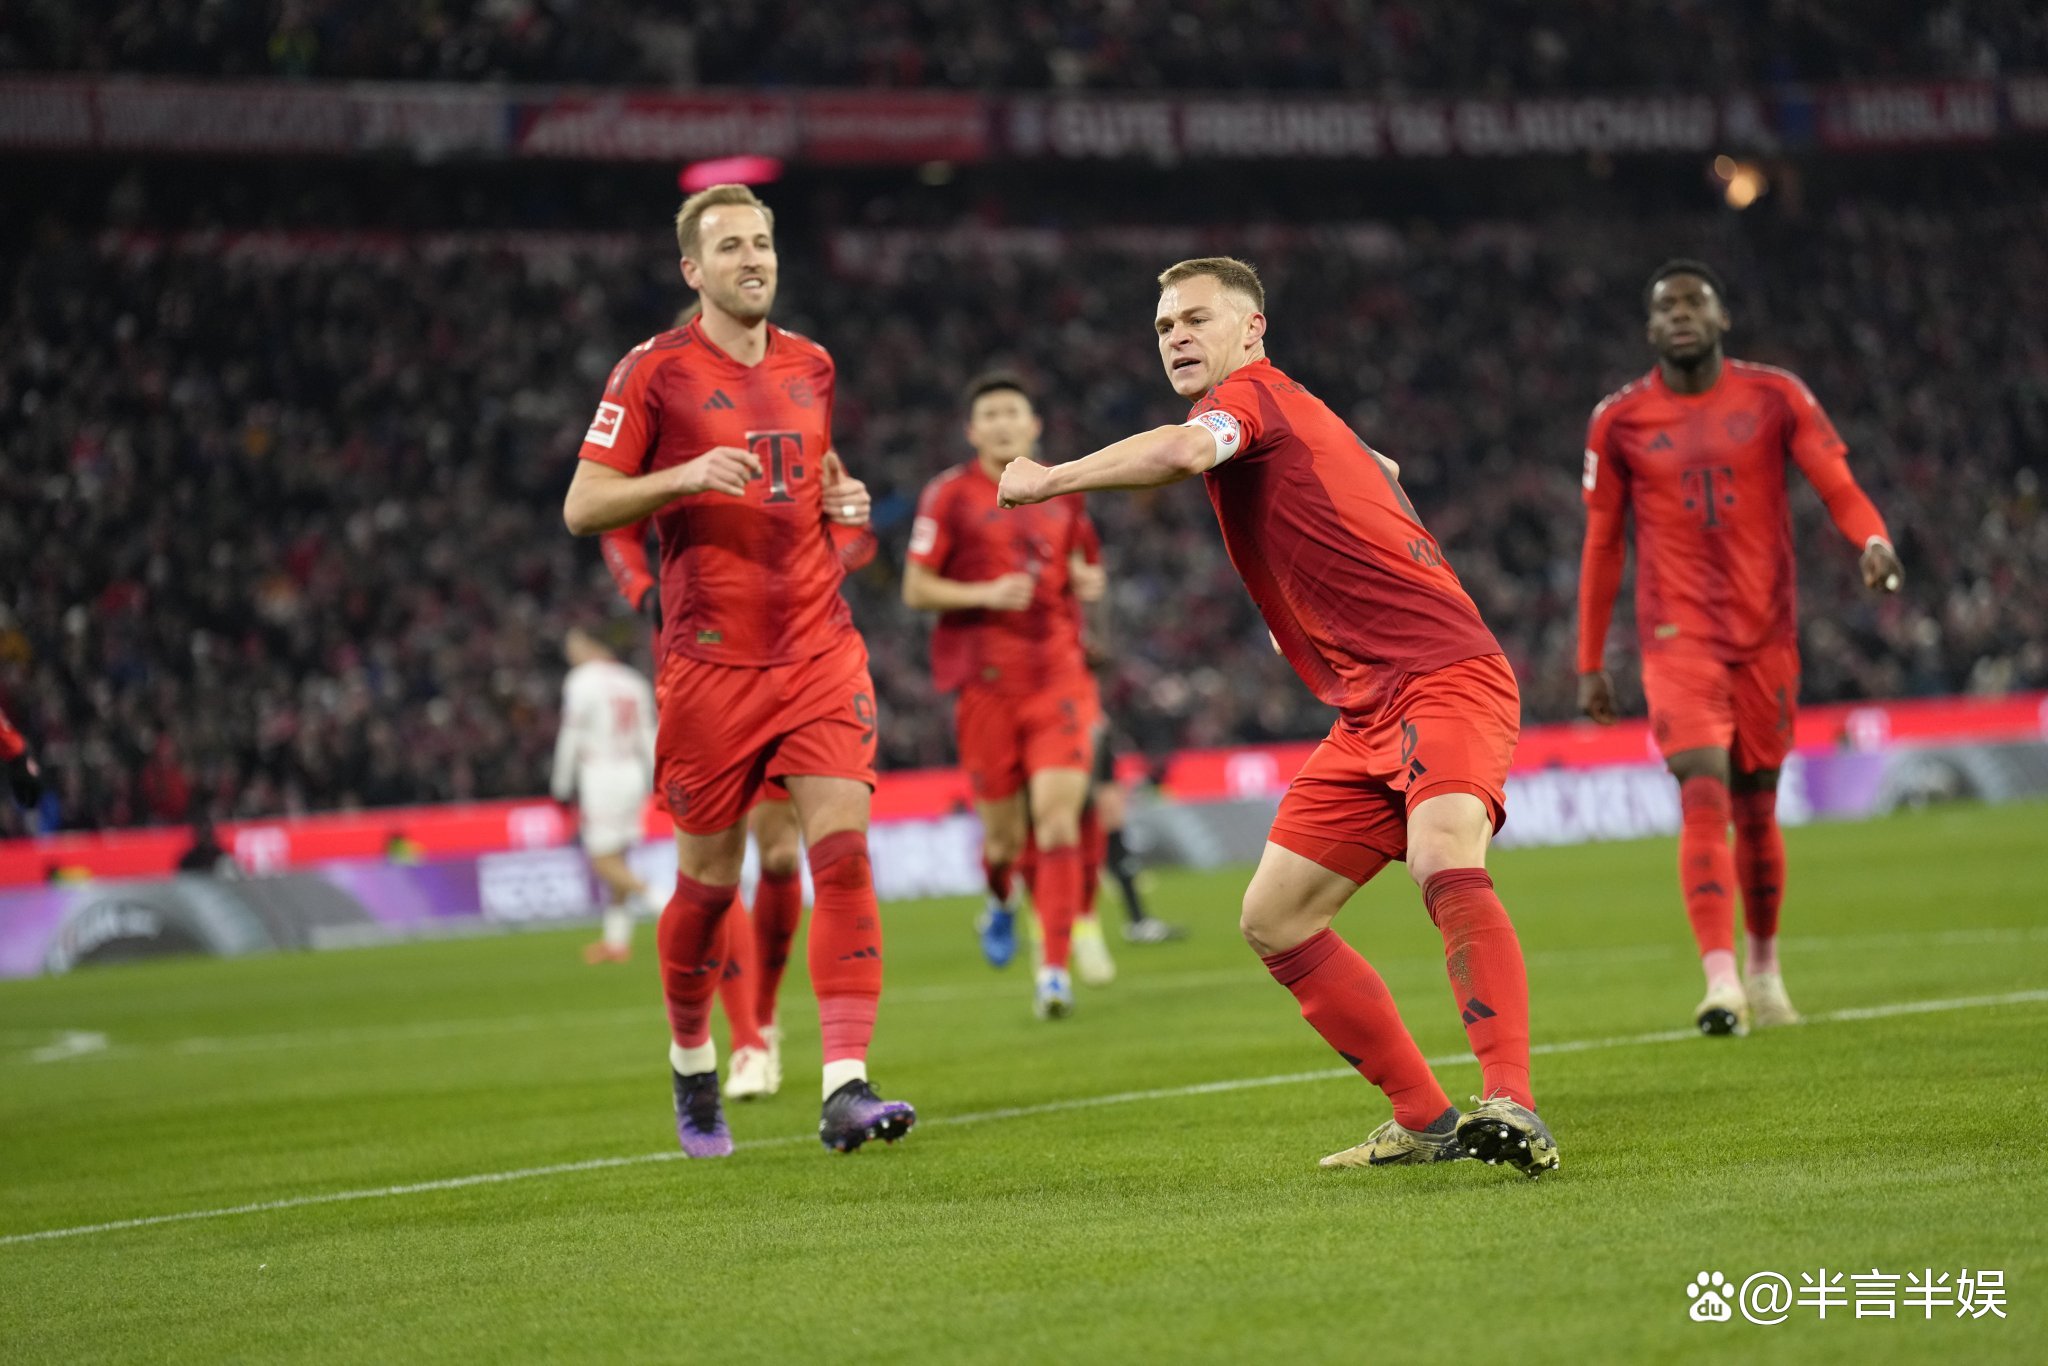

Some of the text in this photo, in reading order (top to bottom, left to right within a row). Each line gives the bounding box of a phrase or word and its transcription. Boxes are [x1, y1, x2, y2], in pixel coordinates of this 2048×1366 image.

[745, 430, 804, 505] T
[1681, 465, 1736, 531] T
[853, 692, 876, 745] 9
